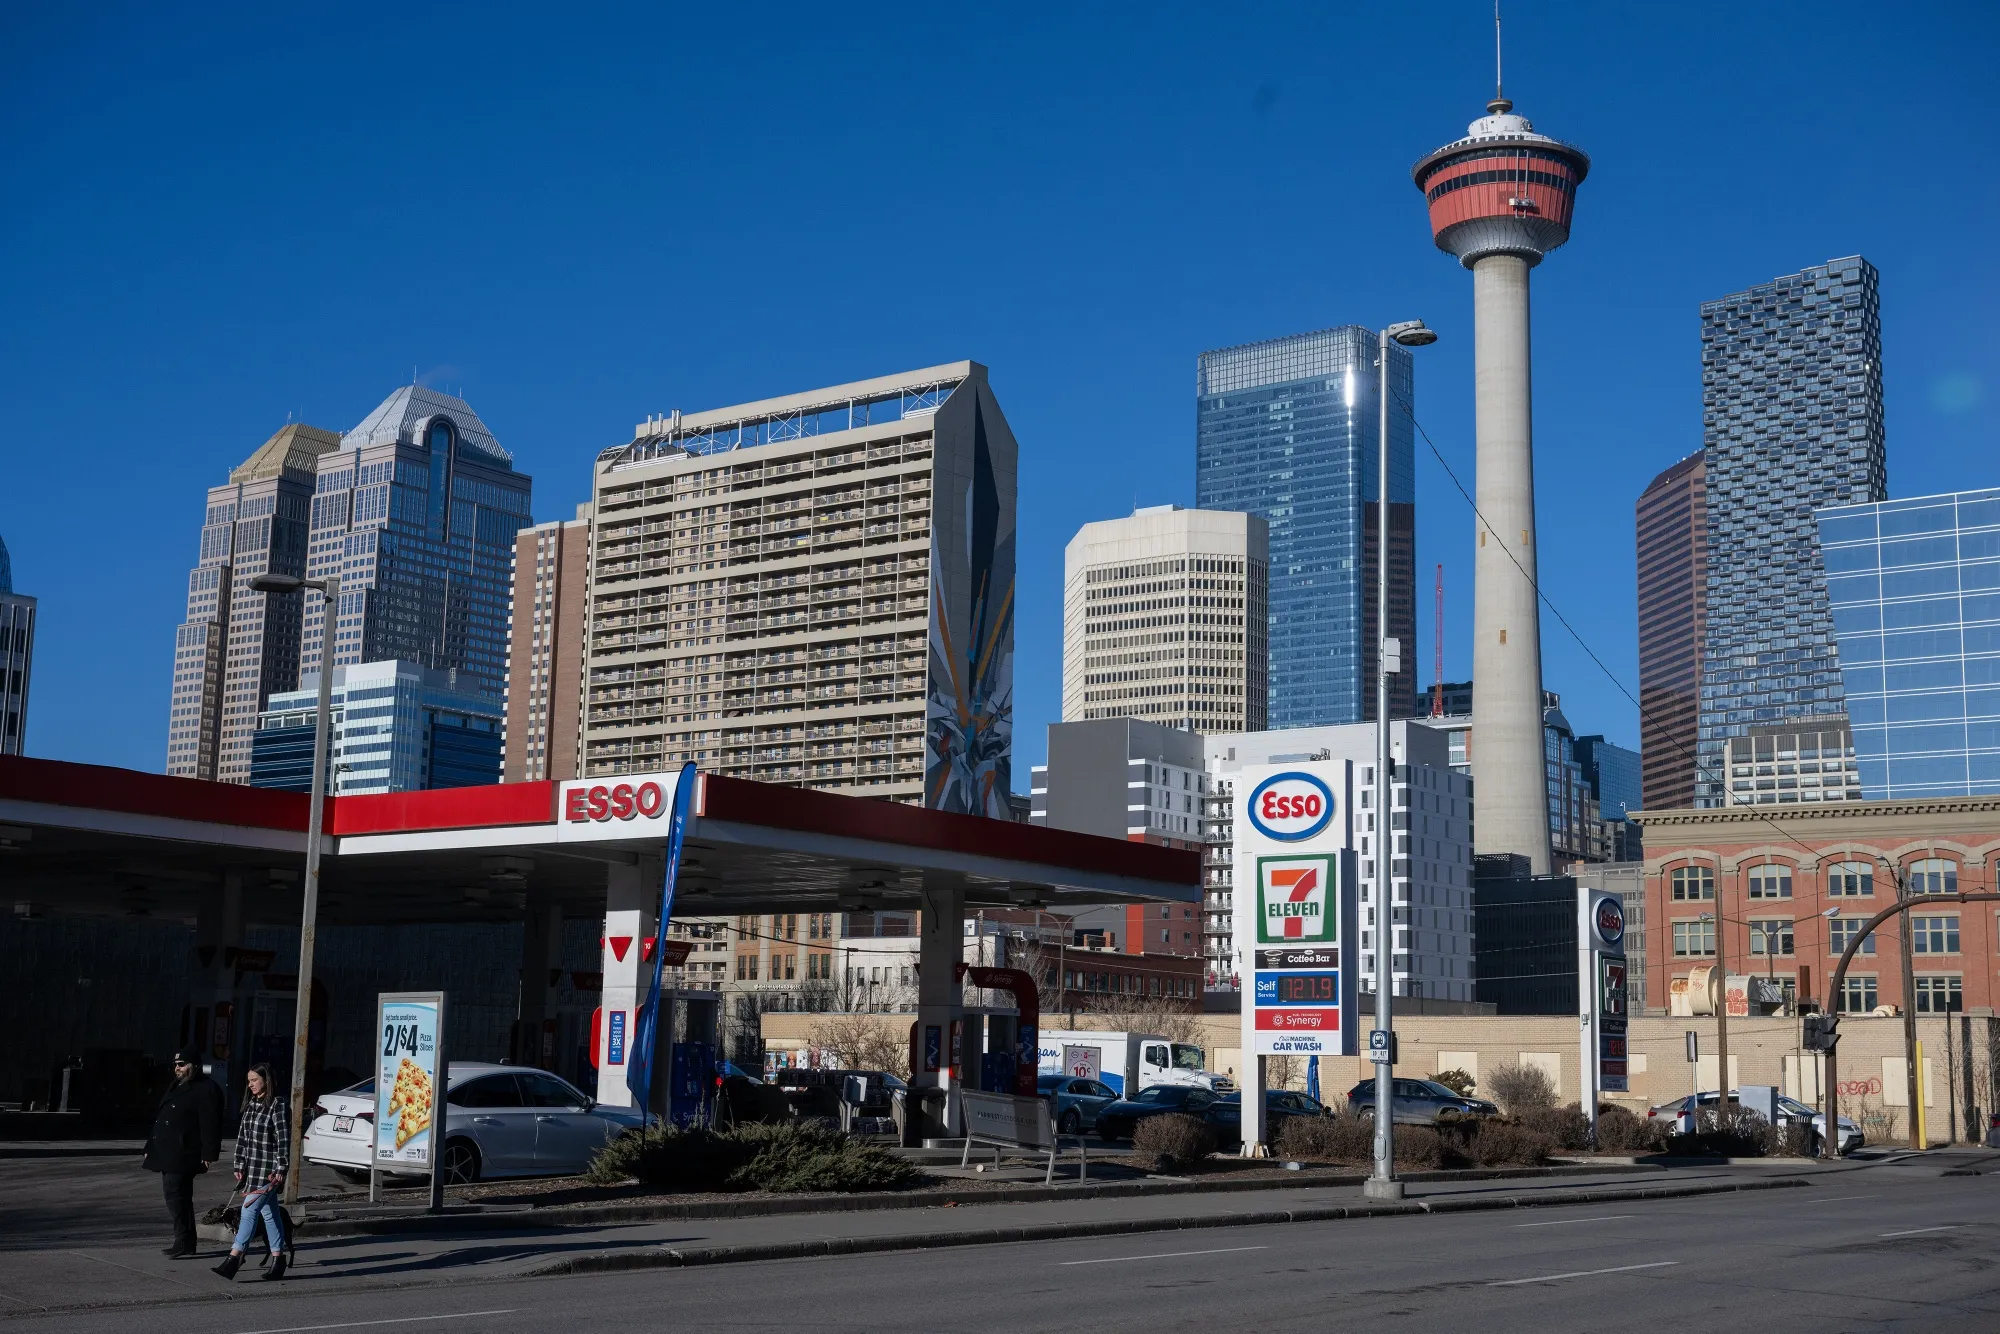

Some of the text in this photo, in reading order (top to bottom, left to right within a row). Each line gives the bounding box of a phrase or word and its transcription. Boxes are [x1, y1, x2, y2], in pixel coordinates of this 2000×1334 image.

[566, 782, 664, 821] ESSO
[1271, 868, 1317, 937] 7
[1287, 954, 1315, 963] Coffee
[1315, 954, 1331, 963] Bar
[1257, 980, 1276, 991] Self
[1286, 1016, 1322, 1027] Synergy
[384, 1024, 418, 1056] 2/$4
[420, 1033, 432, 1041] Pizza
[612, 1038, 621, 1046] 3X
[420, 1043, 433, 1051] Slices
[1273, 1043, 1322, 1051] CAR WASH
